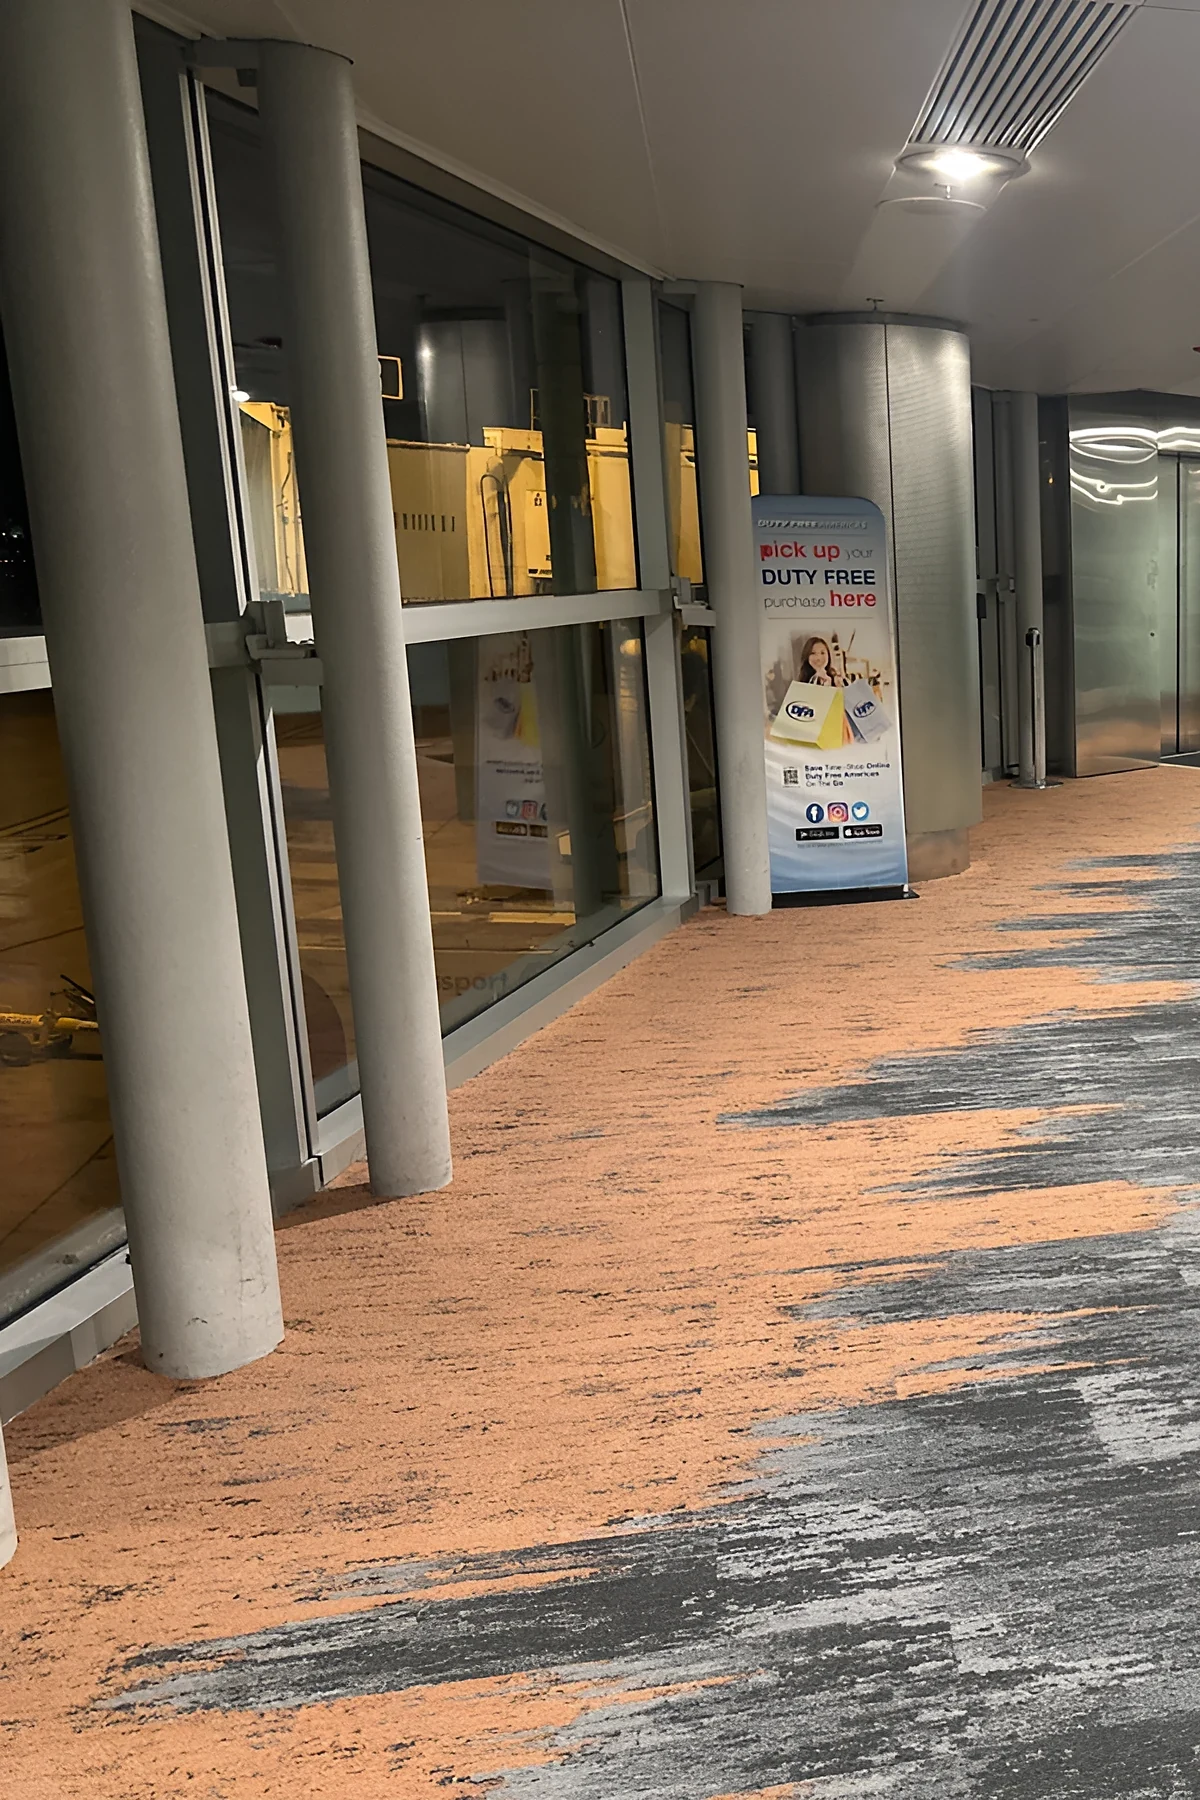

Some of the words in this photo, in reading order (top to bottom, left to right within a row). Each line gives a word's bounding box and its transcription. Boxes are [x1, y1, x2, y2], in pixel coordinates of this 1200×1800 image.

[760, 540, 807, 561] pick
[814, 545, 840, 562] up
[845, 549, 874, 561] your
[762, 569, 817, 585] DUTY
[824, 569, 876, 585] FREE
[764, 596, 826, 611] purchase
[830, 590, 877, 607] here
[832, 779, 844, 787] Go
